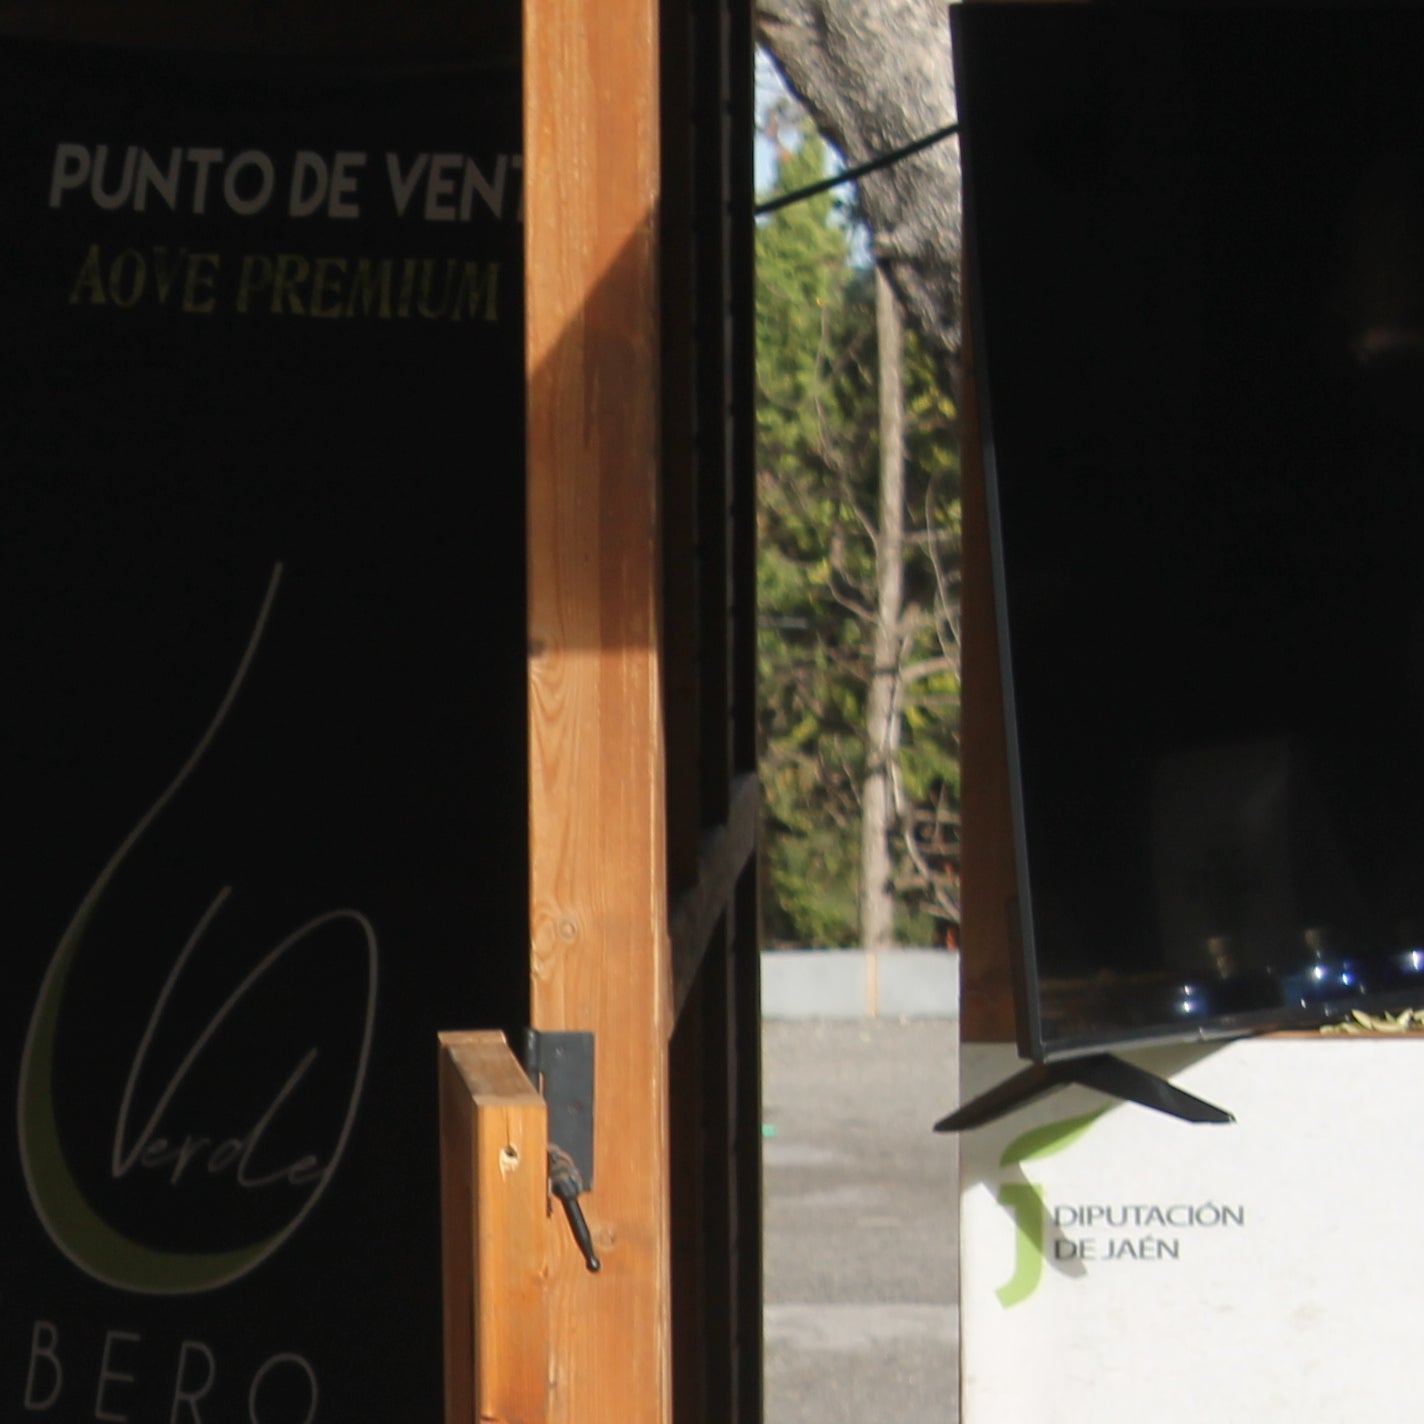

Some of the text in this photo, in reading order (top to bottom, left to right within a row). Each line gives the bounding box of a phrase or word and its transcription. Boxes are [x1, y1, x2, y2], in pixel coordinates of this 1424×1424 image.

[48, 142, 523, 222] PUNTO DE VEN
[68, 243, 500, 322] AOVE PREMIUM
[1054, 1201, 1244, 1227] DIPUTACIÓN
[1054, 1235, 1180, 1260] DE JAÉN
